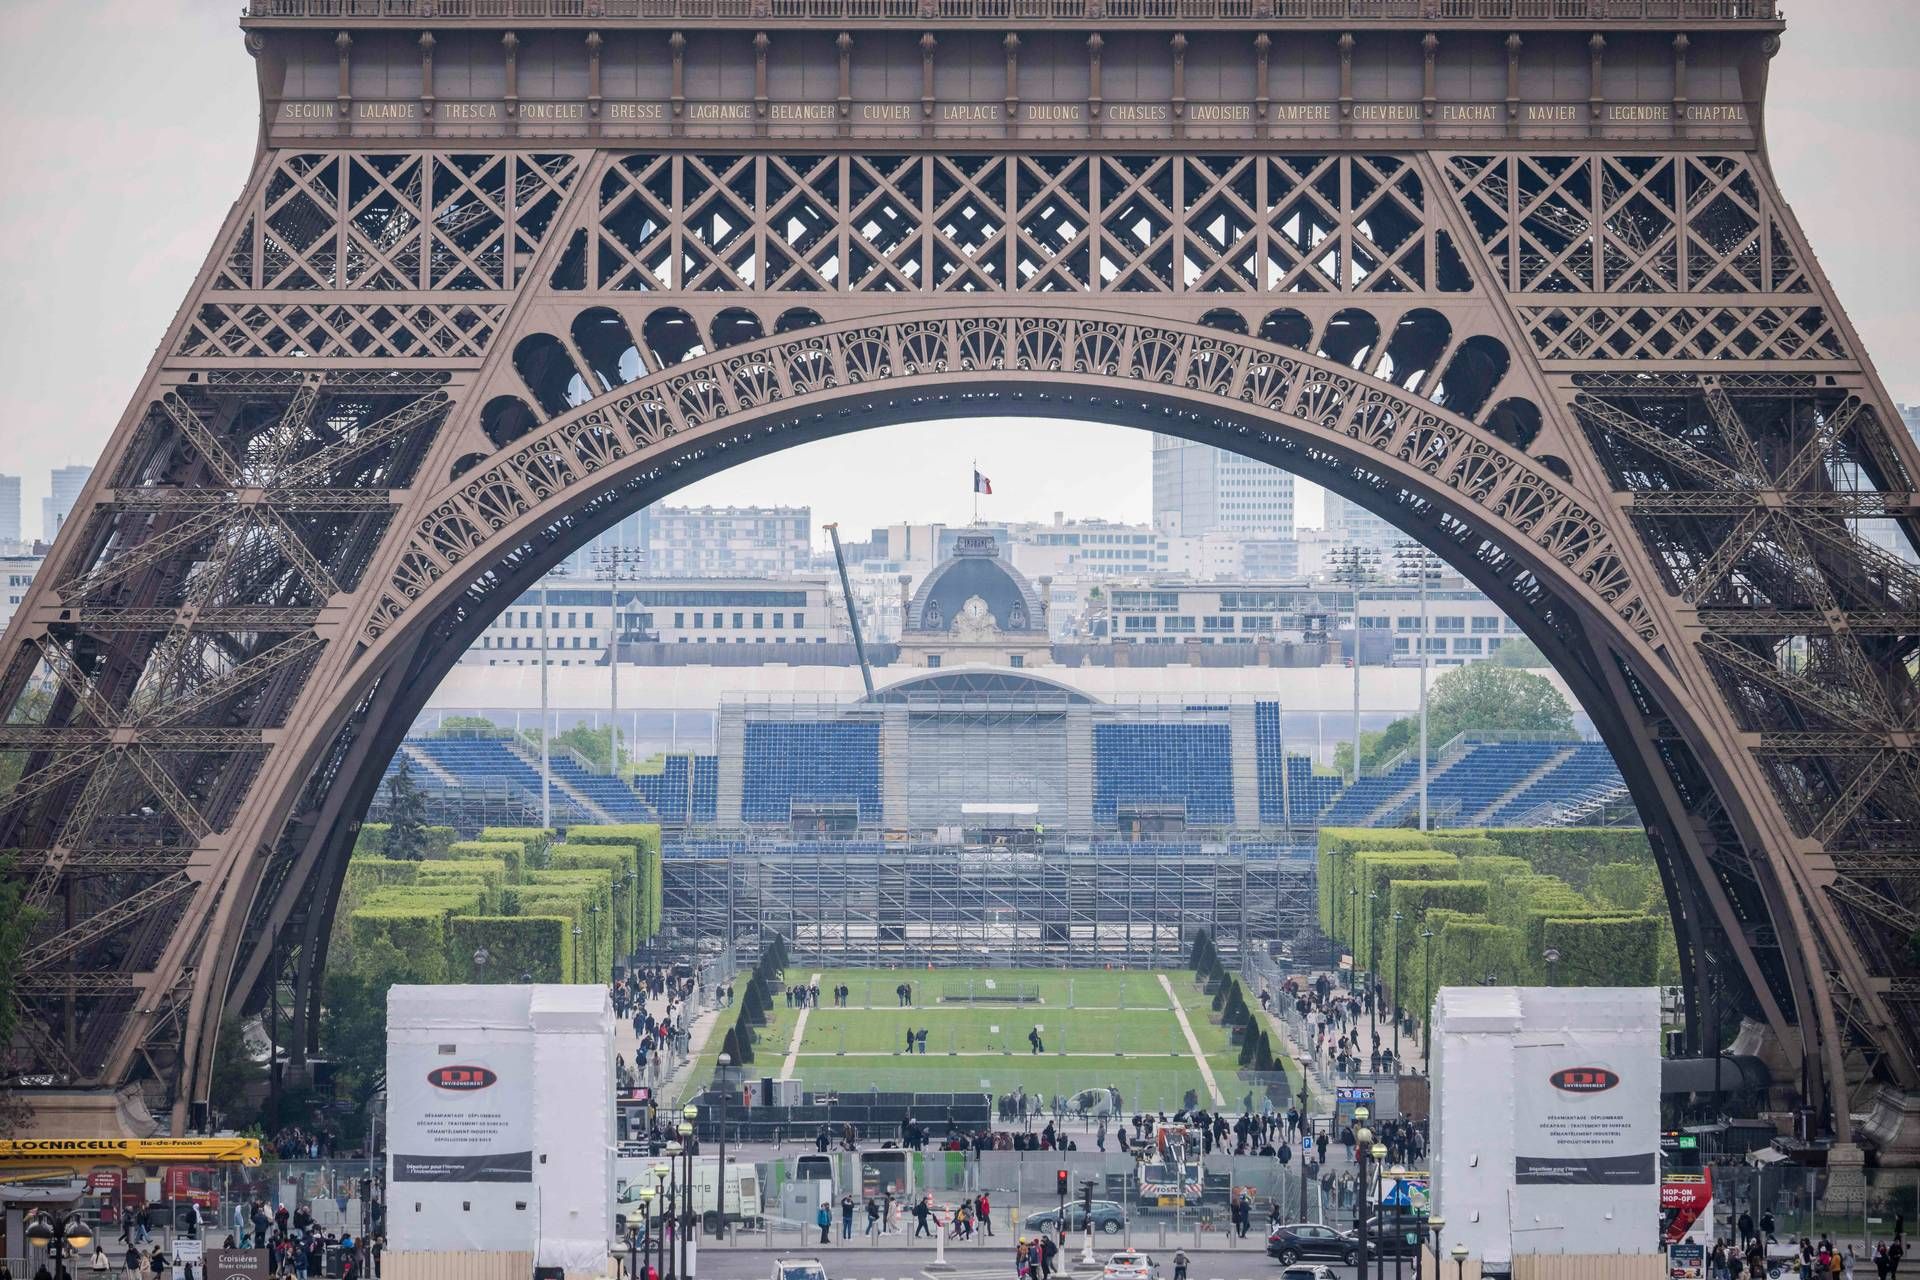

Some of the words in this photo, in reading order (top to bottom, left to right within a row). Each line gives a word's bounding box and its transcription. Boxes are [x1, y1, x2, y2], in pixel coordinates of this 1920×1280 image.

[286, 104, 333, 118] SEGUIN
[360, 104, 415, 118] LALANDE
[444, 104, 497, 118] TRESCA
[519, 104, 585, 118] PONCELET
[611, 104, 663, 118] BRESSE
[690, 105, 751, 120] LAGRANGE
[771, 105, 836, 120] BELANGER
[863, 105, 911, 120] CUVIER
[944, 105, 998, 120] LAPLACE
[1029, 105, 1079, 120] DULONG
[1109, 105, 1166, 120] CHASLES
[1191, 105, 1250, 120] LAVOISIER
[1278, 105, 1331, 120] AMPERE
[1353, 105, 1421, 120] CHEVREUL
[1443, 105, 1497, 120] FLACHAT
[1528, 106, 1576, 120] NAVIER
[1609, 106, 1669, 120] LEGENDRE
[1686, 106, 1743, 120] CHAPTAL
[12, 1140, 128, 1150] LOCNACELLE
[218, 1254, 258, 1263] Croisières
